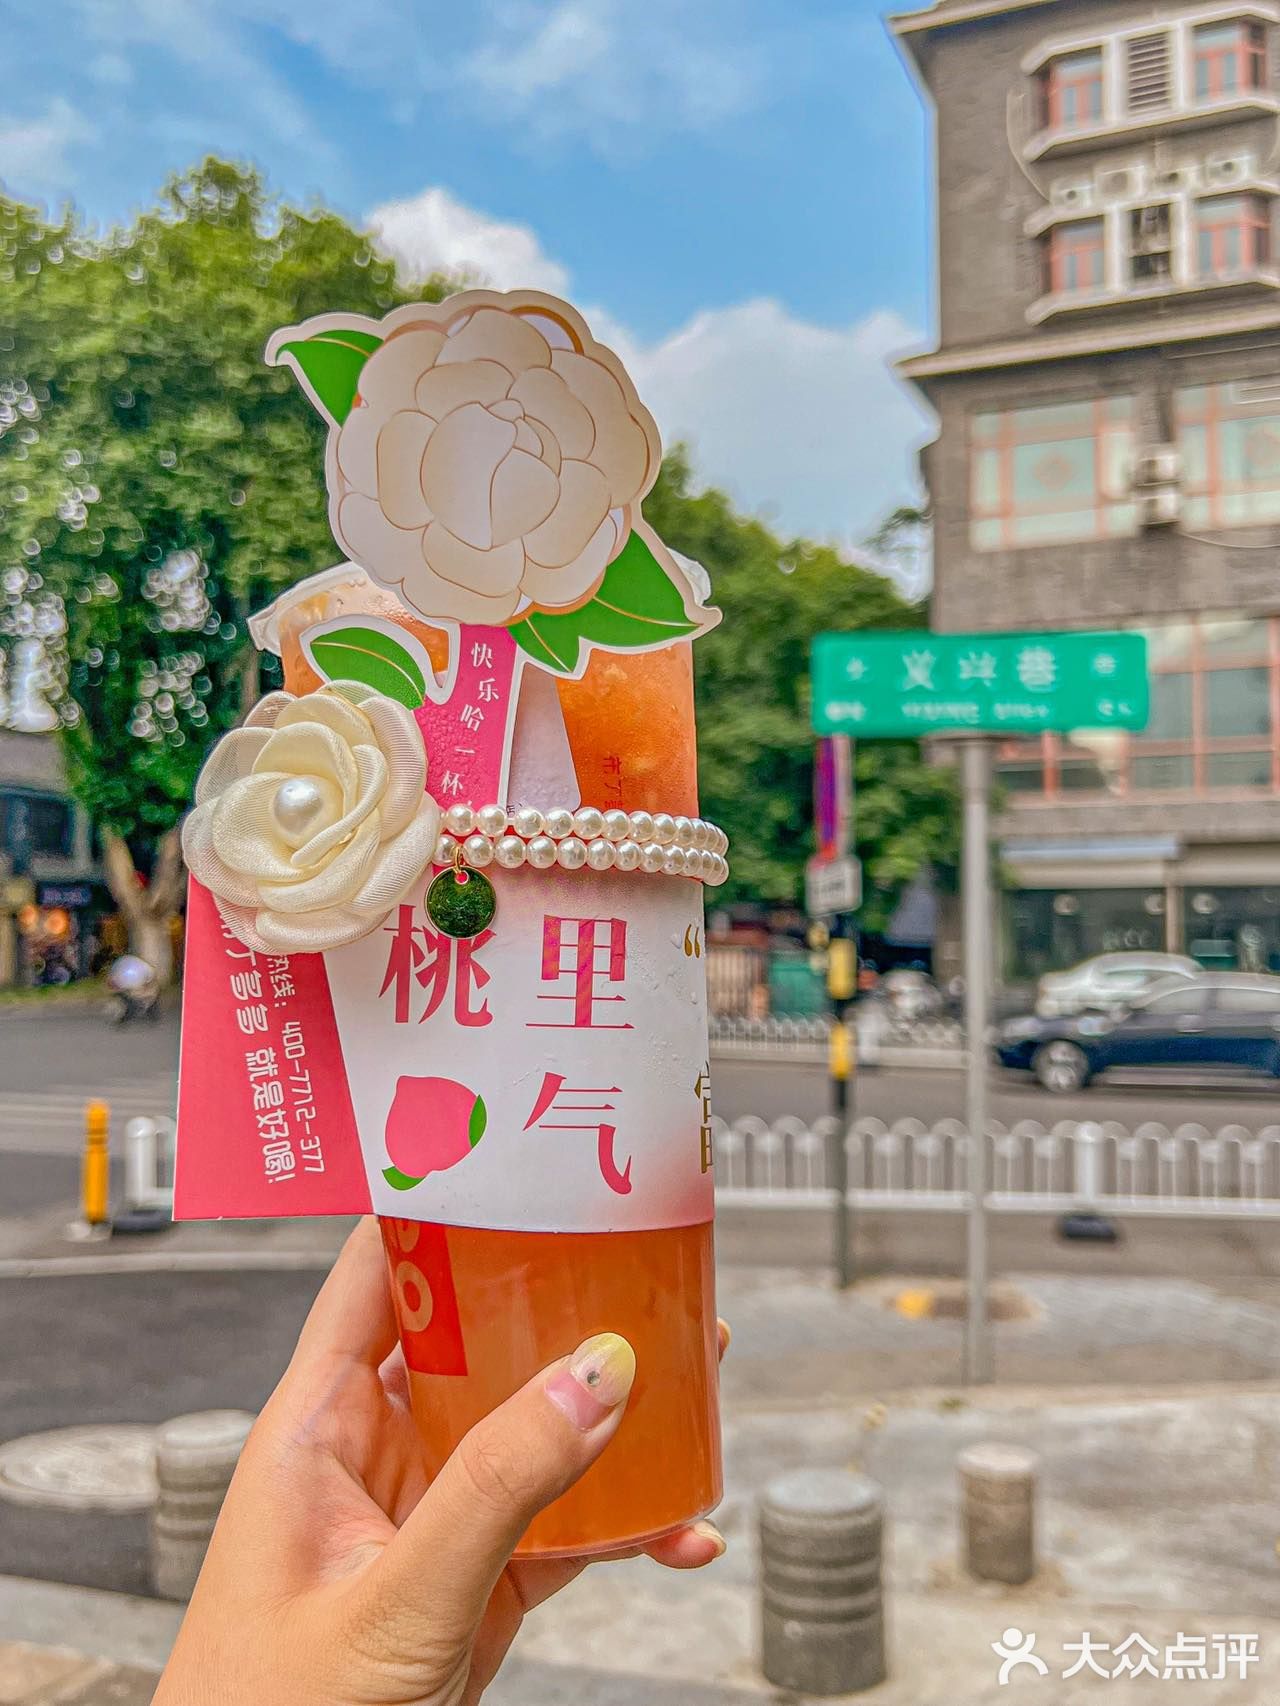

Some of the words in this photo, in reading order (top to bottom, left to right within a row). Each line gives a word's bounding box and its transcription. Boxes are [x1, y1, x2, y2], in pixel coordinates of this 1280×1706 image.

[441, 642, 499, 796] 快乐哈一杯
[522, 1072, 632, 1195] 气
